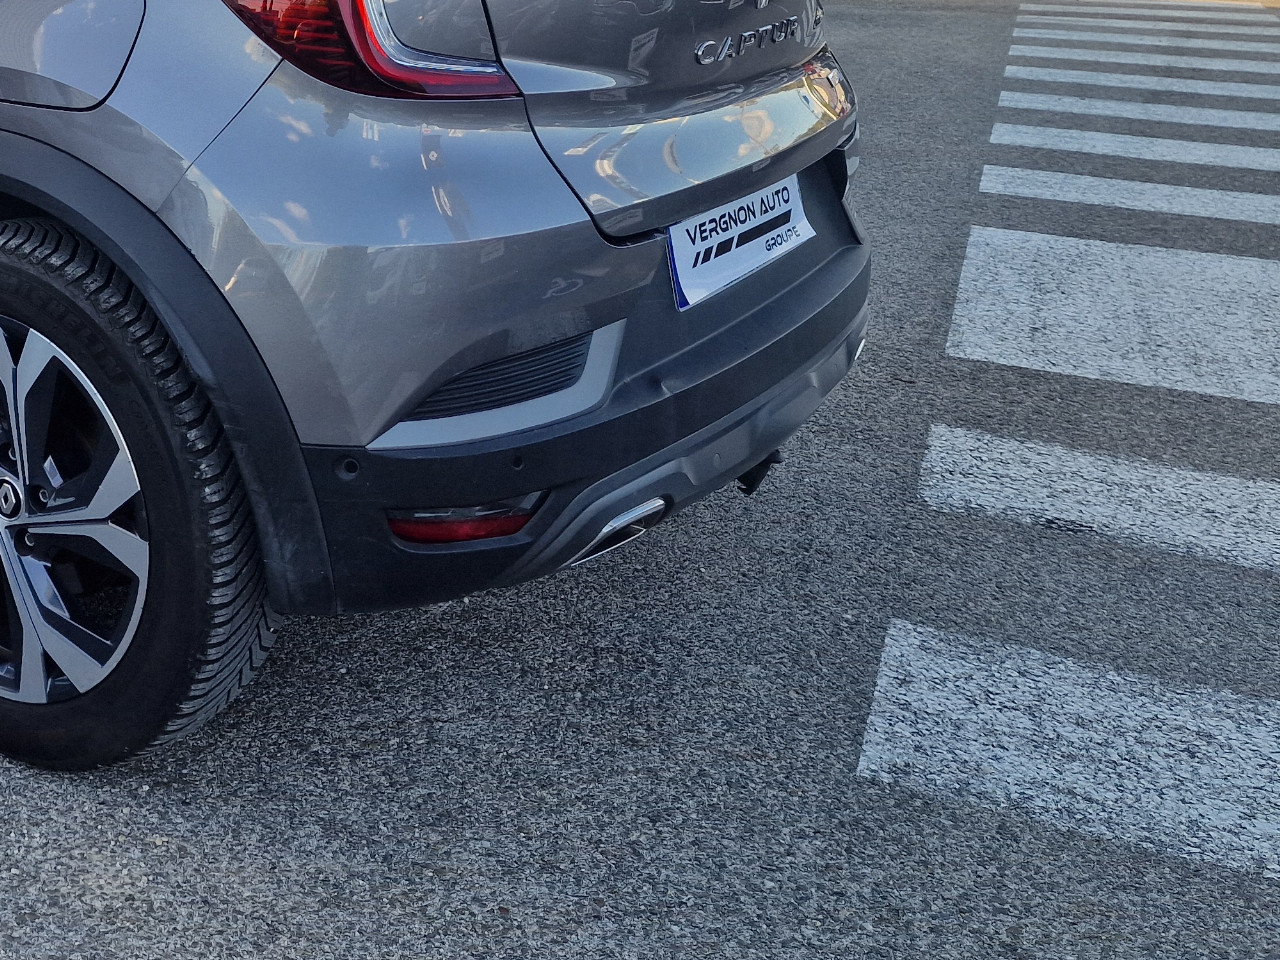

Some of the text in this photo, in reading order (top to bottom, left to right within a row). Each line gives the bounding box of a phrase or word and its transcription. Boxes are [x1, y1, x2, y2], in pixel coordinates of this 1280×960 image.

[685, 186, 790, 246] VERGNON AUTO
[765, 225, 800, 252] GROUPE
